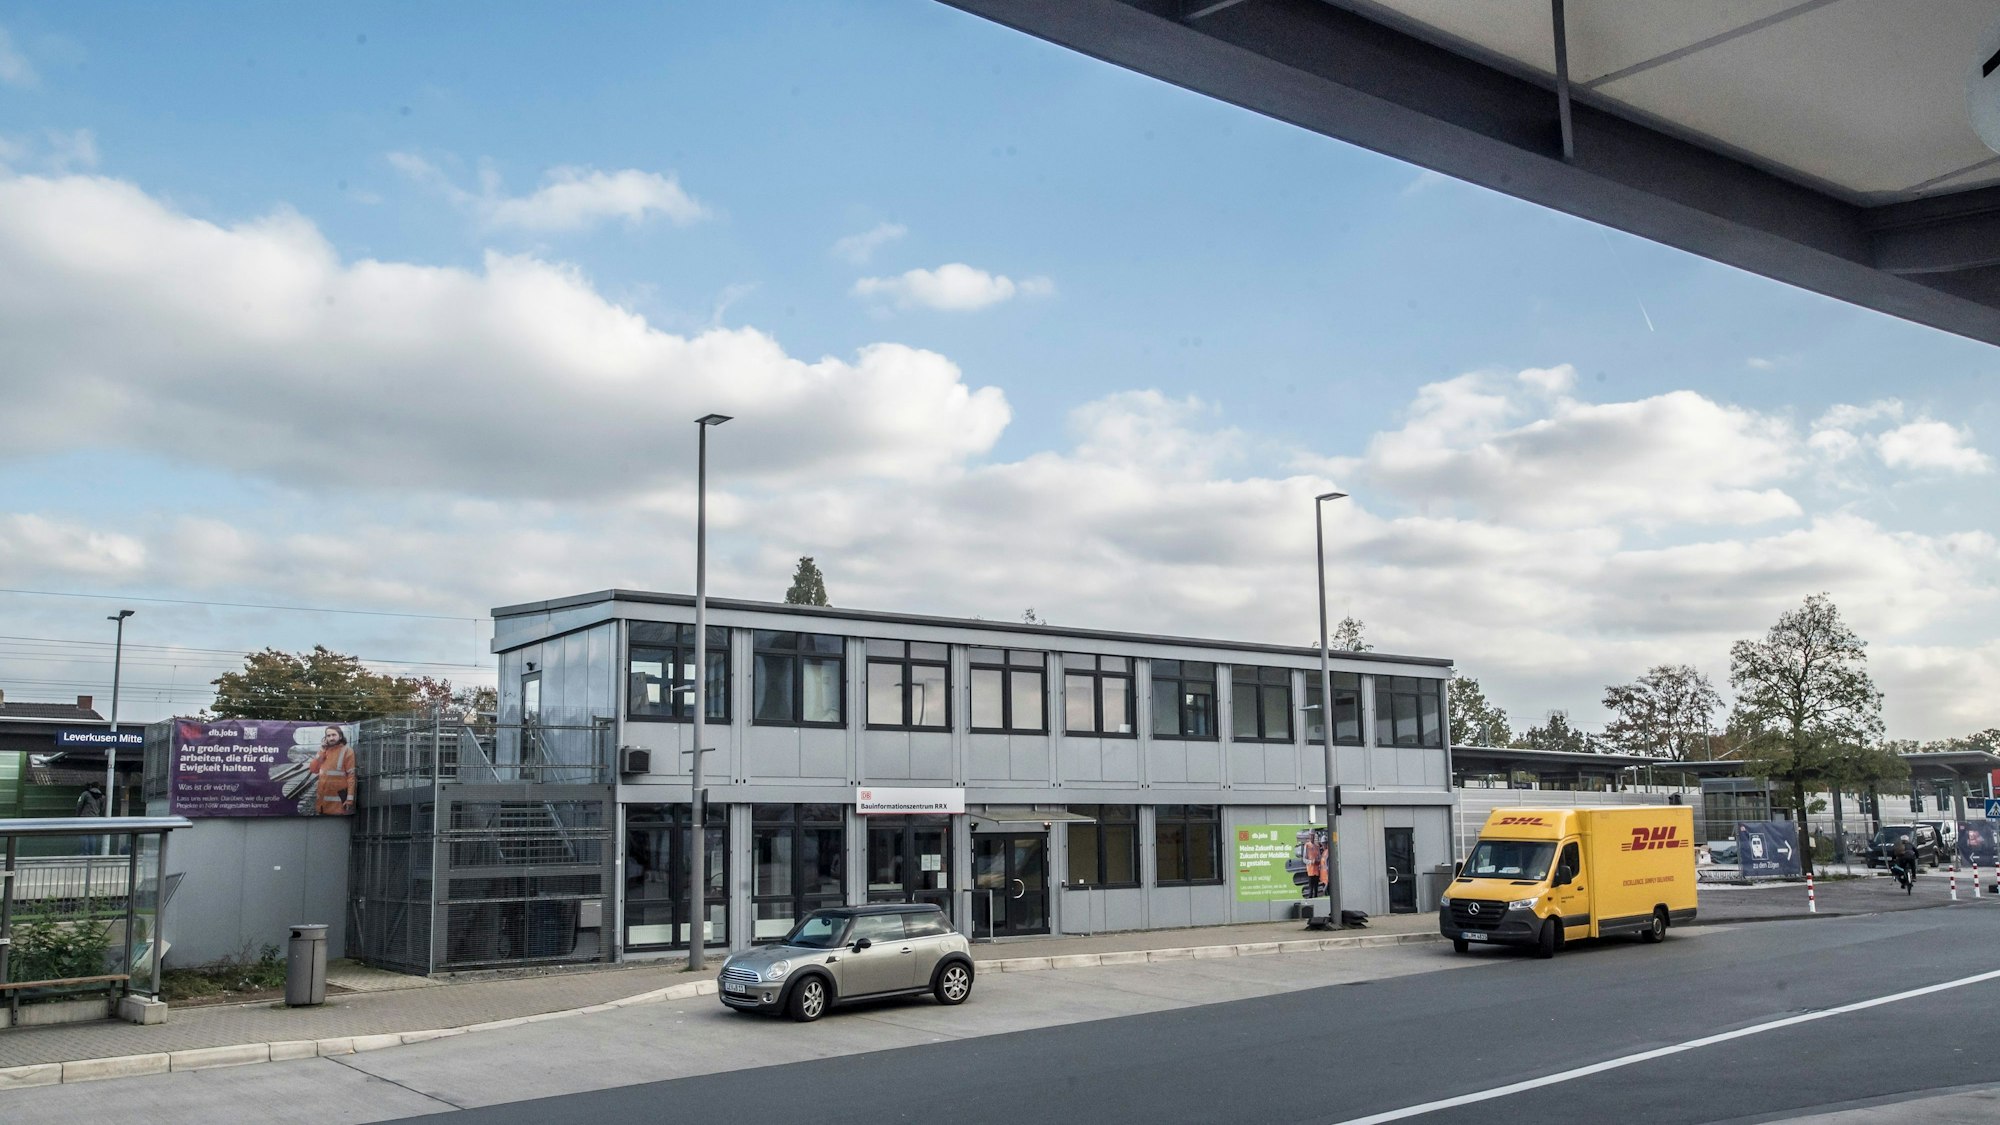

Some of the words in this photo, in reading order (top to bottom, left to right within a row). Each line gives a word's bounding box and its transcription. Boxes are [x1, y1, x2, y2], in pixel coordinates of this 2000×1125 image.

[63, 732, 117, 743] Leverkusen
[119, 733, 143, 744] Mitte
[208, 729, 238, 738] db.jobs
[180, 743, 196, 753] An
[197, 744, 231, 755] großen
[232, 744, 280, 755] Projekten
[179, 753, 224, 764] arbeiten,
[225, 754, 242, 763] die
[243, 754, 258, 763] für
[259, 754, 274, 763] die
[179, 763, 221, 773] Ewigkeit
[222, 763, 257, 773] halten.
[178, 783, 193, 791] Was
[193, 783, 202, 791] ist
[203, 783, 213, 791] dir
[213, 783, 240, 793] wichtig?
[264, 796, 280, 804] große
[861, 791, 871, 800] DB
[176, 802, 198, 810] Projekte
[219, 802, 251, 810] mitgestalten
[1499, 817, 1545, 826] DHL
[1631, 825, 1680, 852] DHL
[1239, 844, 1255, 852] Meine
[1268, 851, 1290, 859] Mobilität
[1759, 861, 1767, 869] den
[1767, 860, 1779, 869] Zügen
